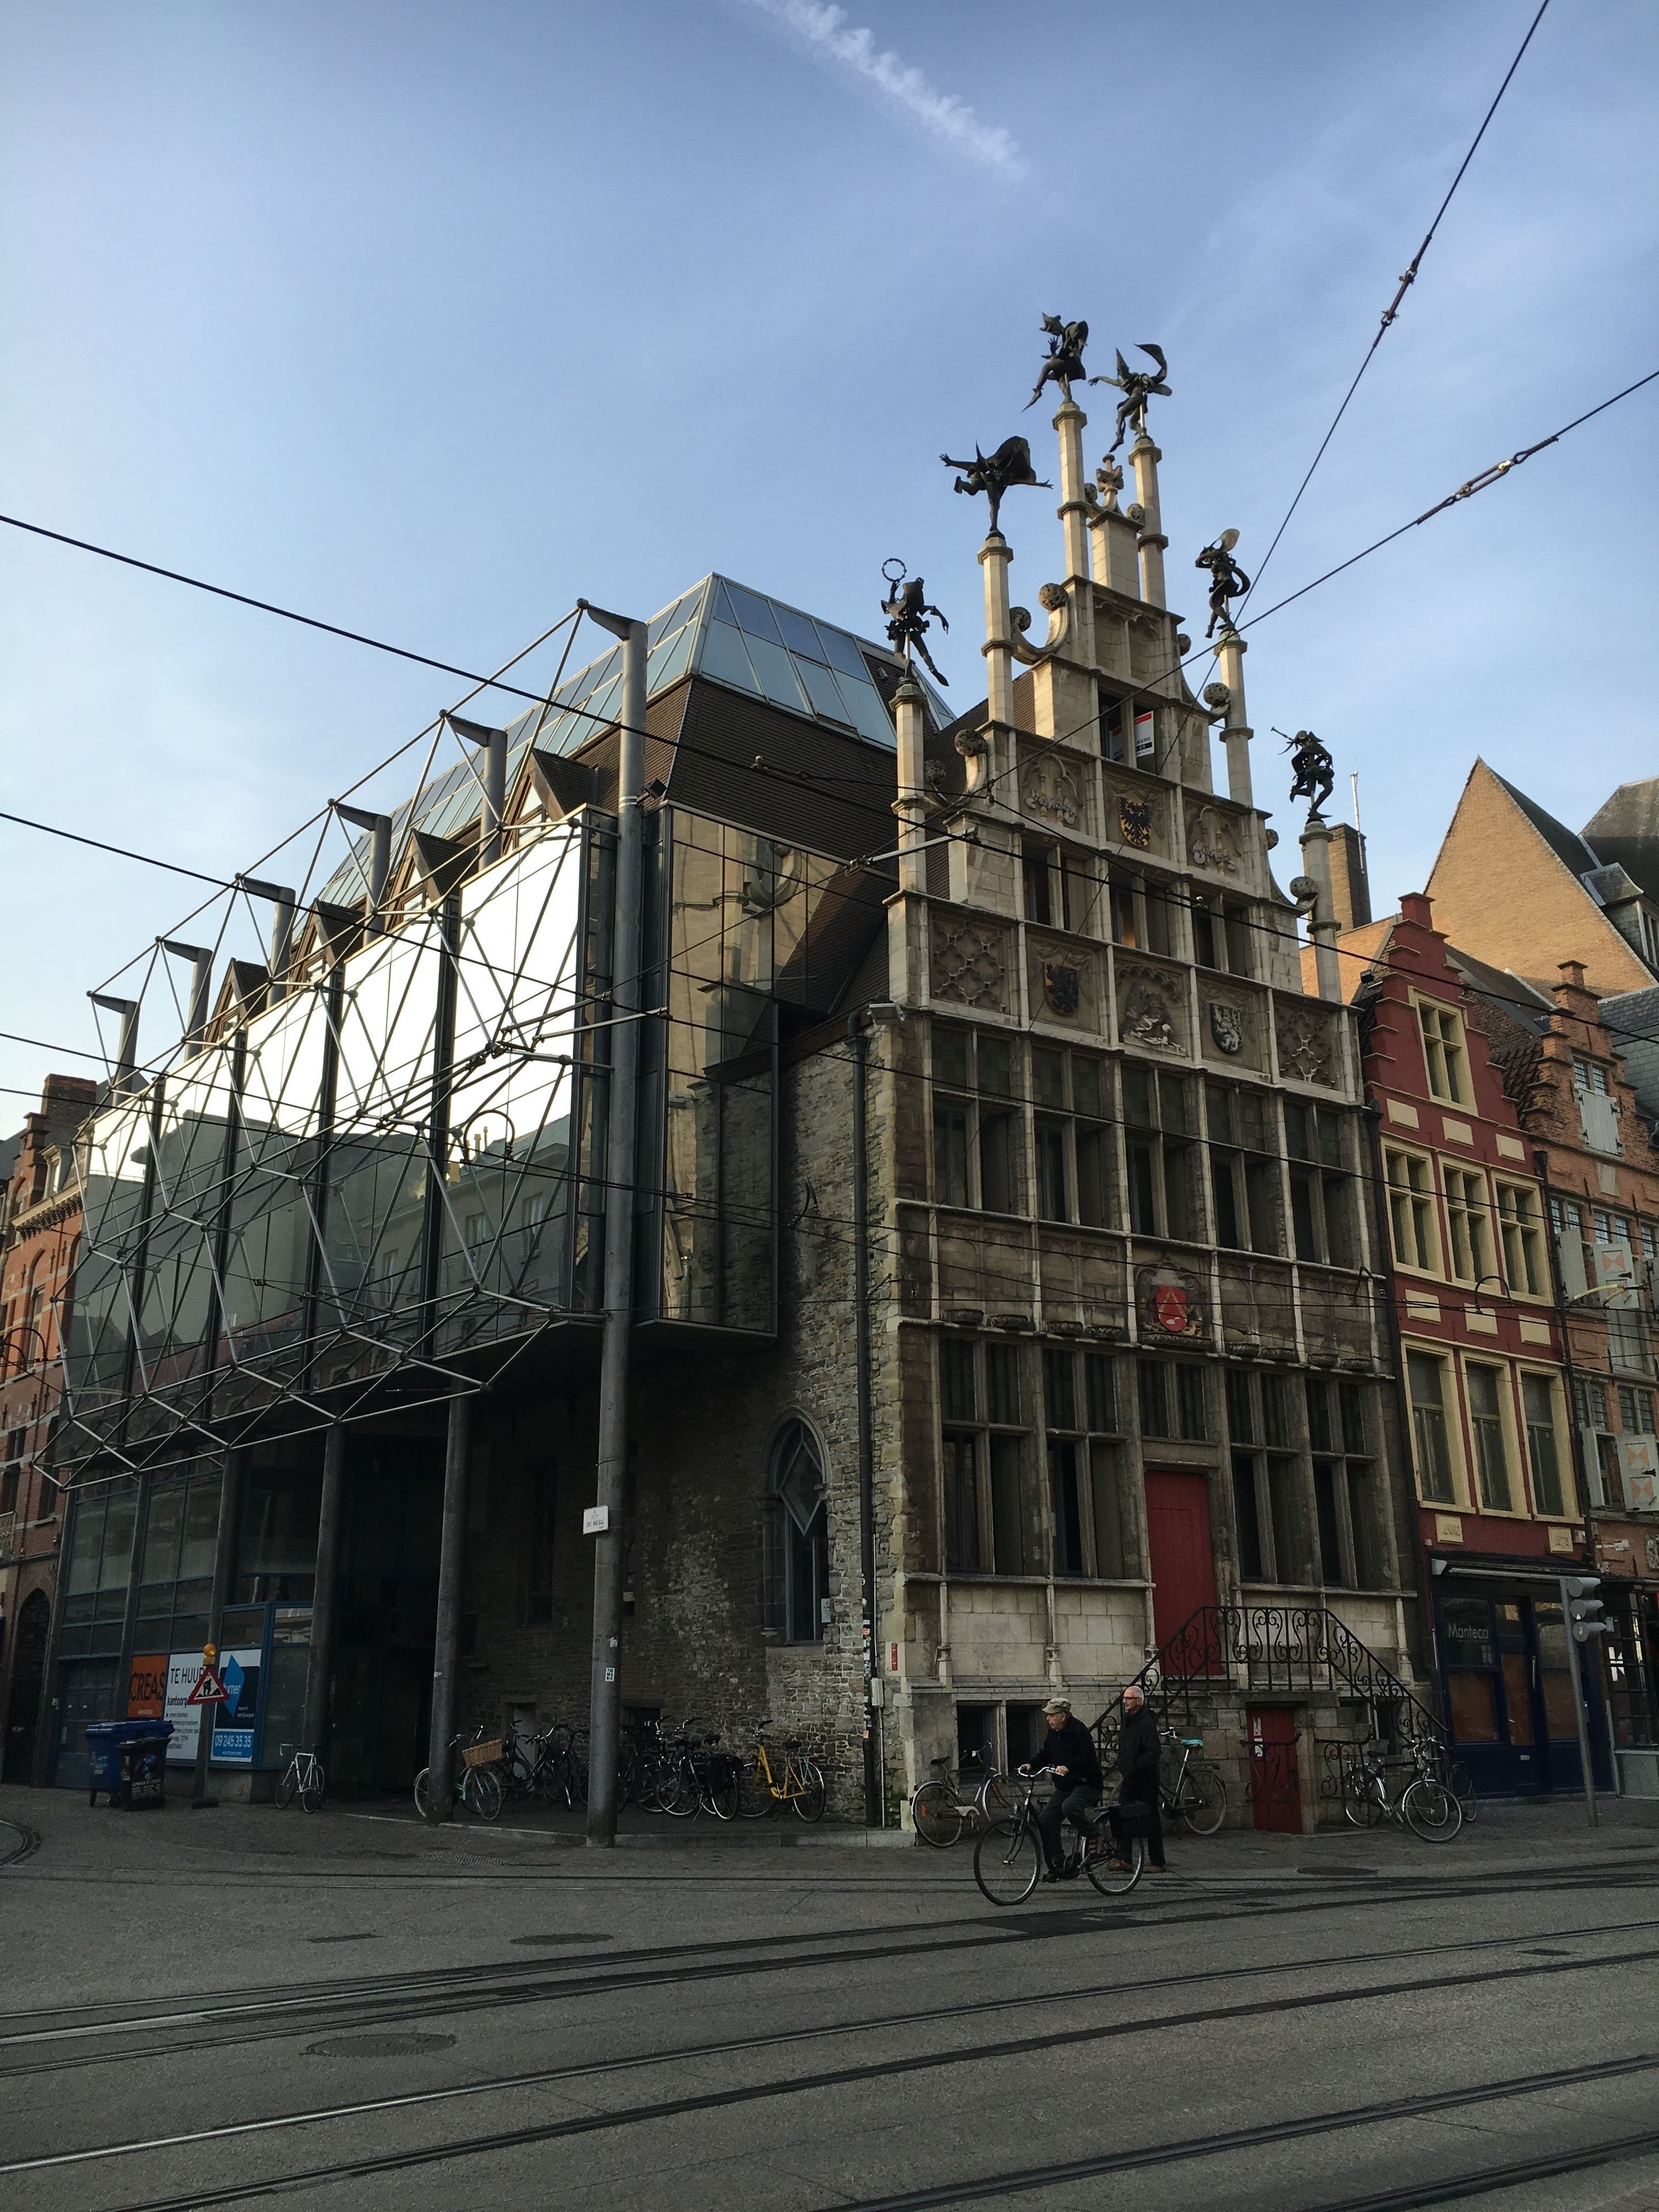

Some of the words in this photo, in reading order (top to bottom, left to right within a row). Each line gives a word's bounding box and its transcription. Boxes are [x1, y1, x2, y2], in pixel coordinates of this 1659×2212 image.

[1448, 1622, 1488, 1639] Manteca
[171, 1668, 180, 1684] TE
[215, 1734, 223, 1747] 09
[223, 1734, 234, 1747] 245
[234, 1735, 243, 1747] 35
[243, 1735, 251, 1748] 35
